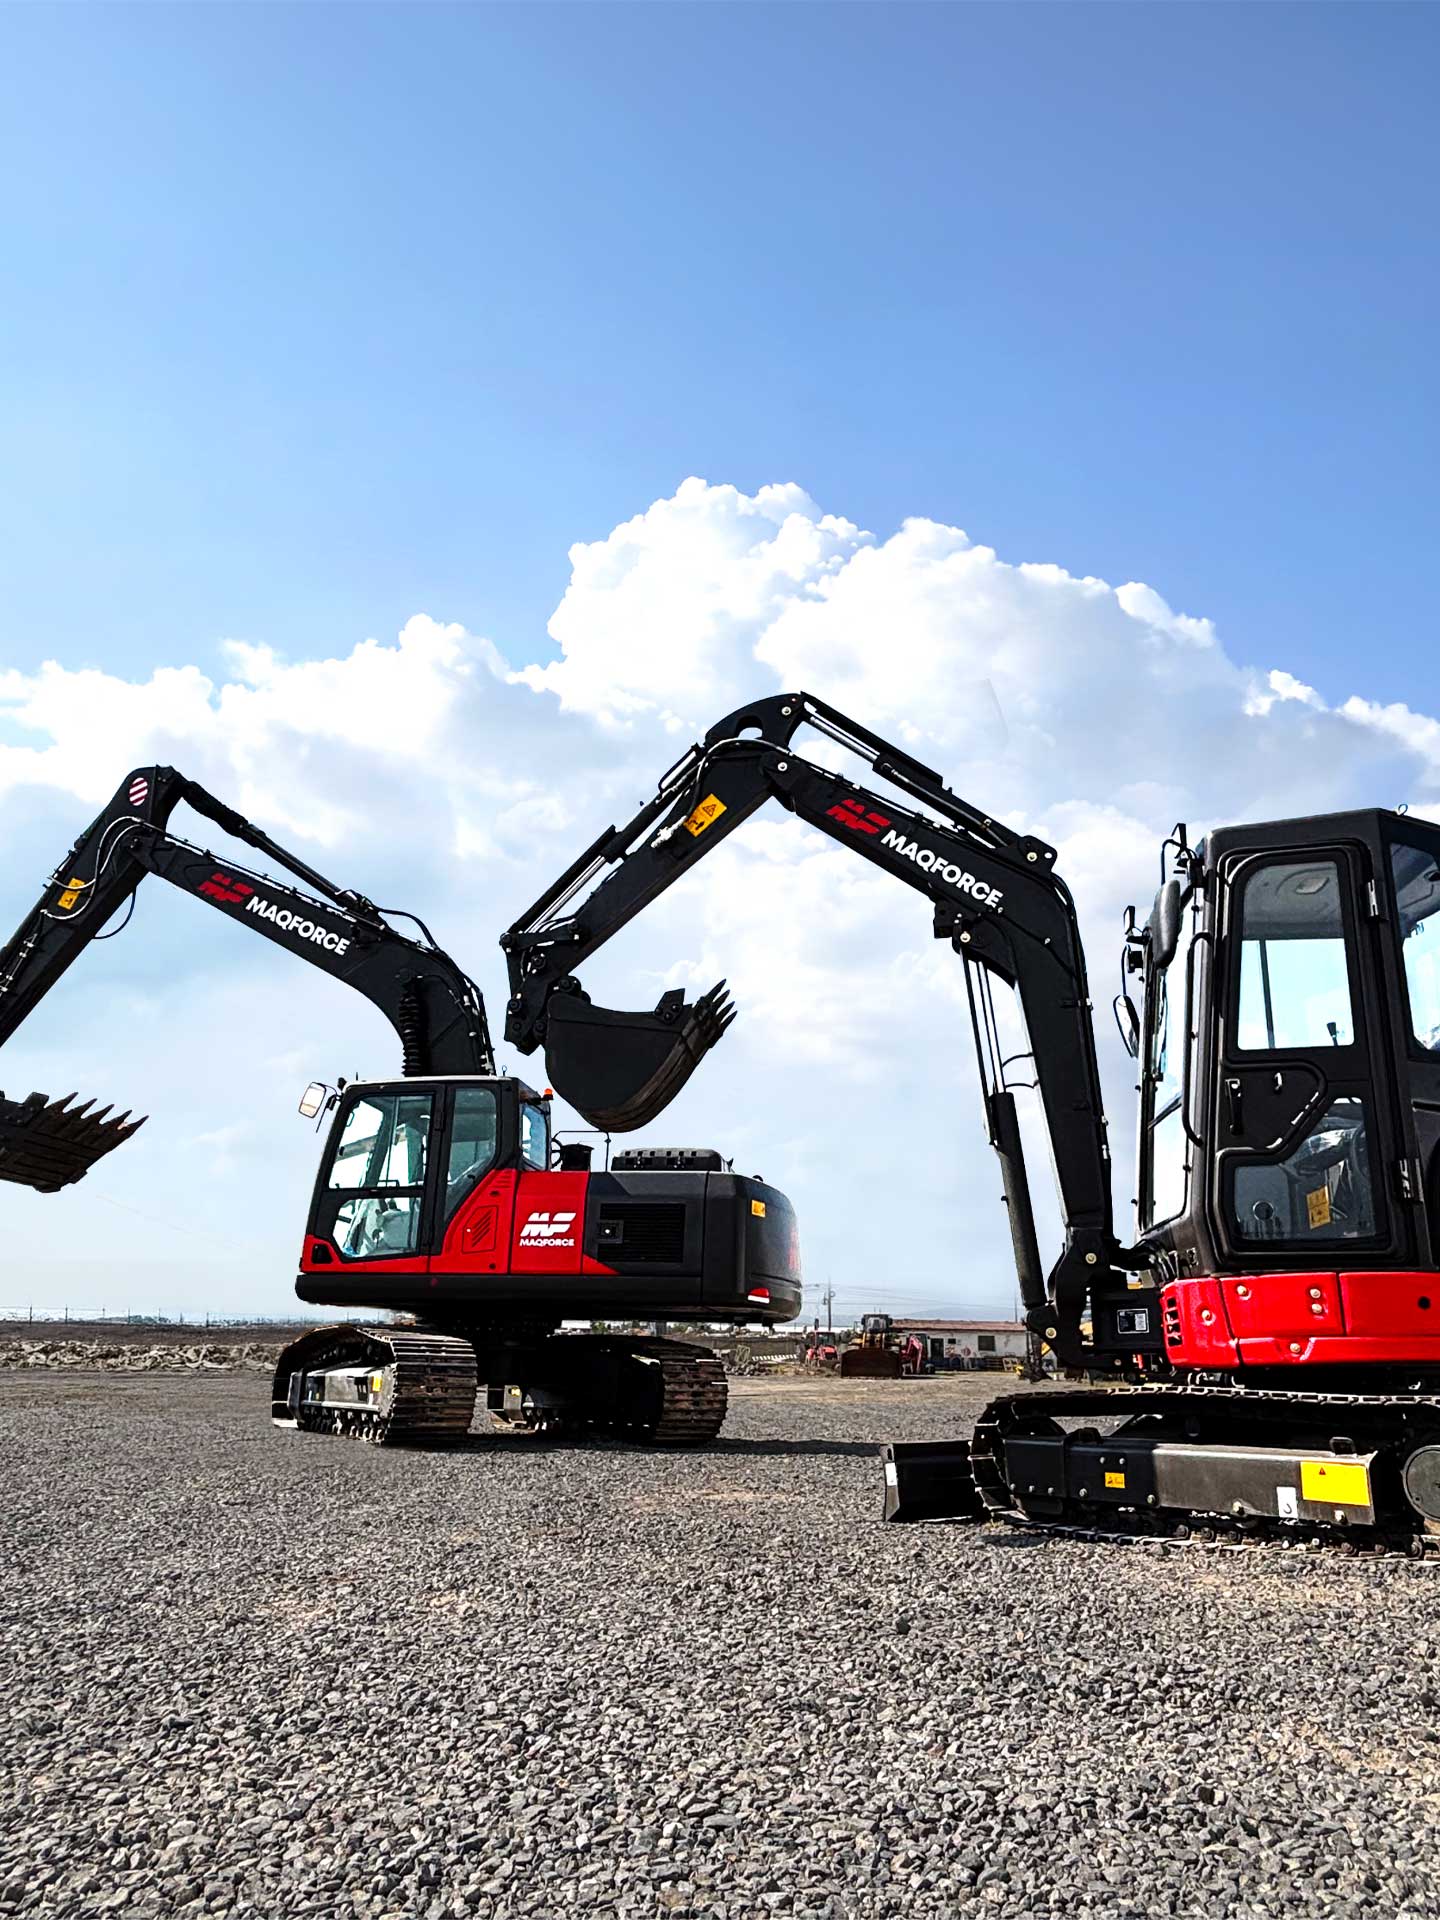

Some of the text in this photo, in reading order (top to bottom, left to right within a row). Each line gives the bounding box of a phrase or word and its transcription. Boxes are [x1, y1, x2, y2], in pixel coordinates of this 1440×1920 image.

[880, 829, 1003, 908] MAQFORCE
[245, 896, 350, 956] MAQFORCE
[519, 1238, 575, 1247] MAQFORCE
